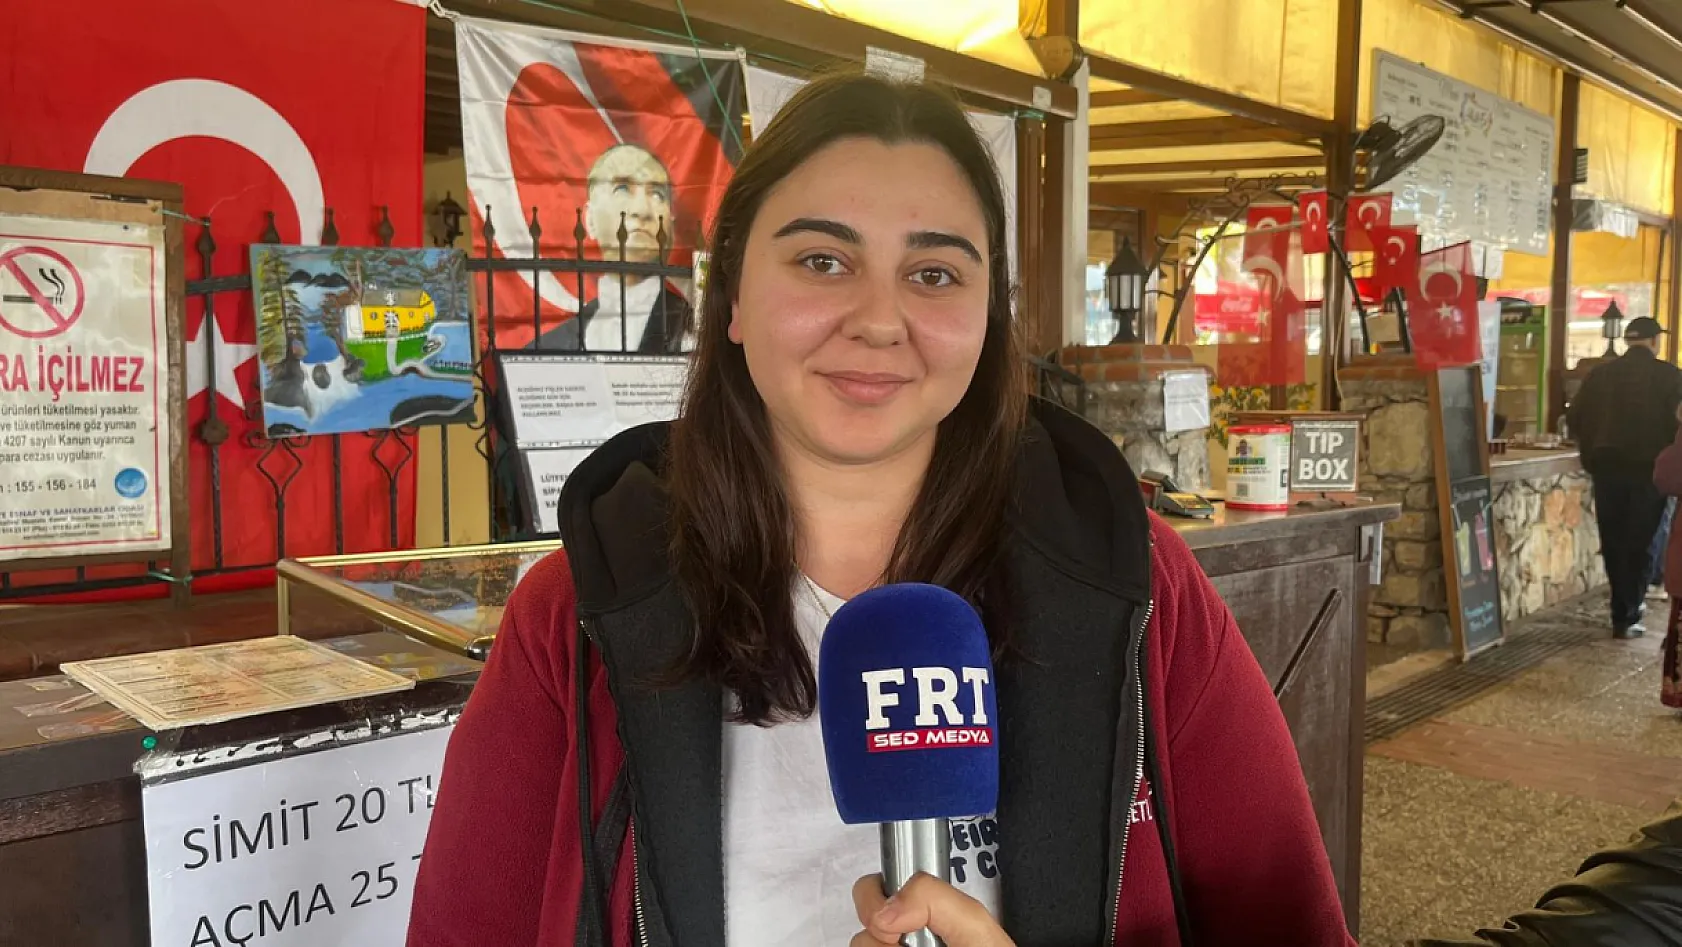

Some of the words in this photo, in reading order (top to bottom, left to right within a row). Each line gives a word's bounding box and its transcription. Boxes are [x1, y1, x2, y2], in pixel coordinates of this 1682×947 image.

[38, 344, 145, 402] İÇİLMEZ
[43, 404, 98, 416] tüketilmesi
[14, 419, 81, 431] tüketilmesine
[84, 421, 101, 433] göz
[104, 421, 137, 432] yuman
[4, 435, 26, 447] 4207
[59, 434, 91, 446] Kanun
[1305, 431, 1344, 454] TIP
[1298, 457, 1349, 480] BOX
[15, 480, 35, 493] 155
[46, 479, 66, 491] 156
[861, 667, 990, 730] FRT
[873, 732, 919, 747] SED
[925, 729, 990, 745] MEDYA
[183, 798, 319, 869] SİMİT
[335, 786, 386, 832] 20
[189, 882, 336, 947] AÇMA
[350, 861, 399, 908] 25
